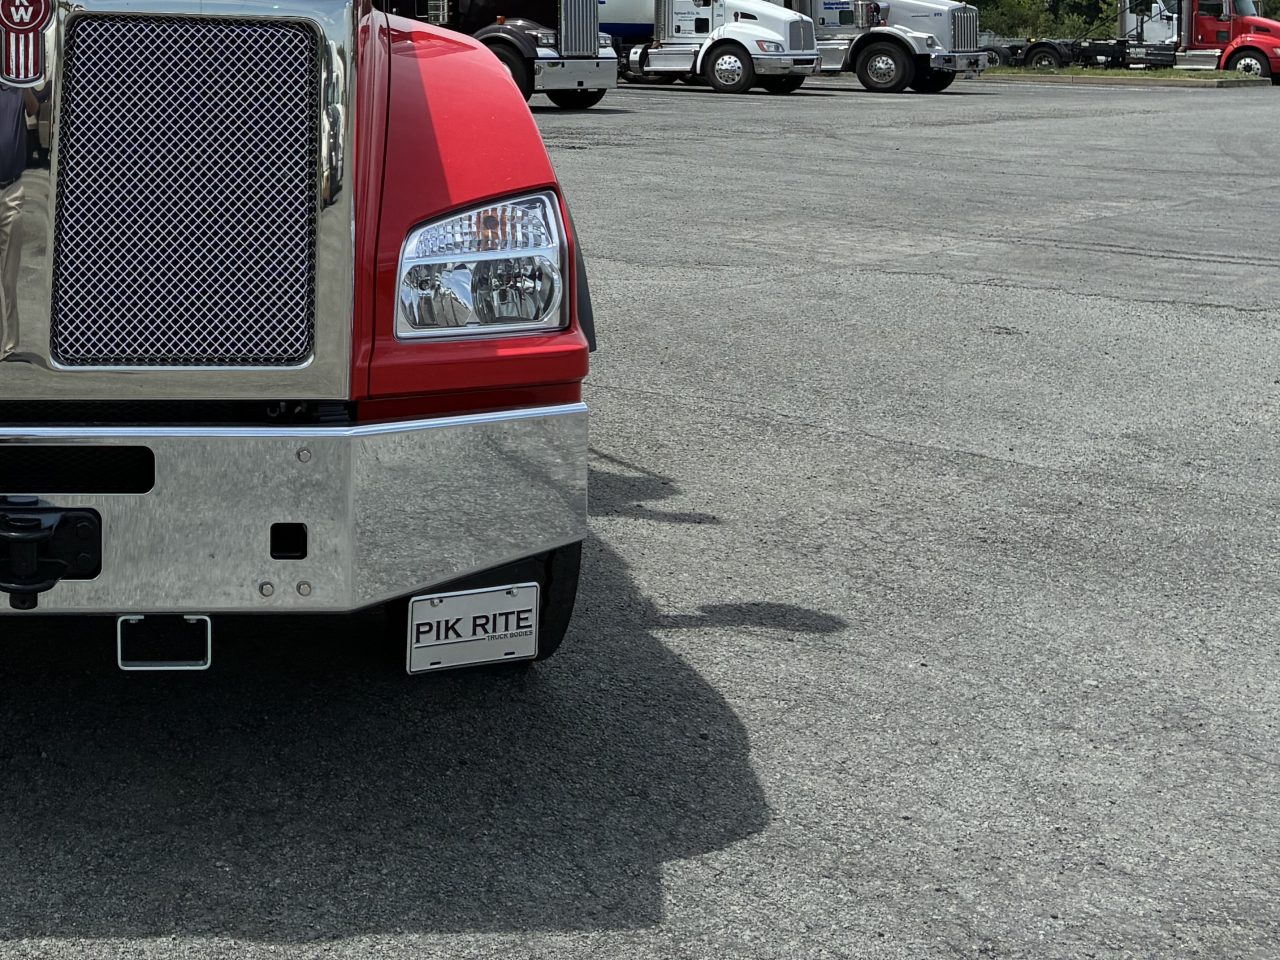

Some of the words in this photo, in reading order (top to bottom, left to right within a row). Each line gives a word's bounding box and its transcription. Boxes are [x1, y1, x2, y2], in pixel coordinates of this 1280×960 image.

[414, 617, 463, 645] PIK
[471, 608, 533, 637] RITE
[486, 633, 509, 642] TRUCK
[509, 629, 534, 639] BODIES
